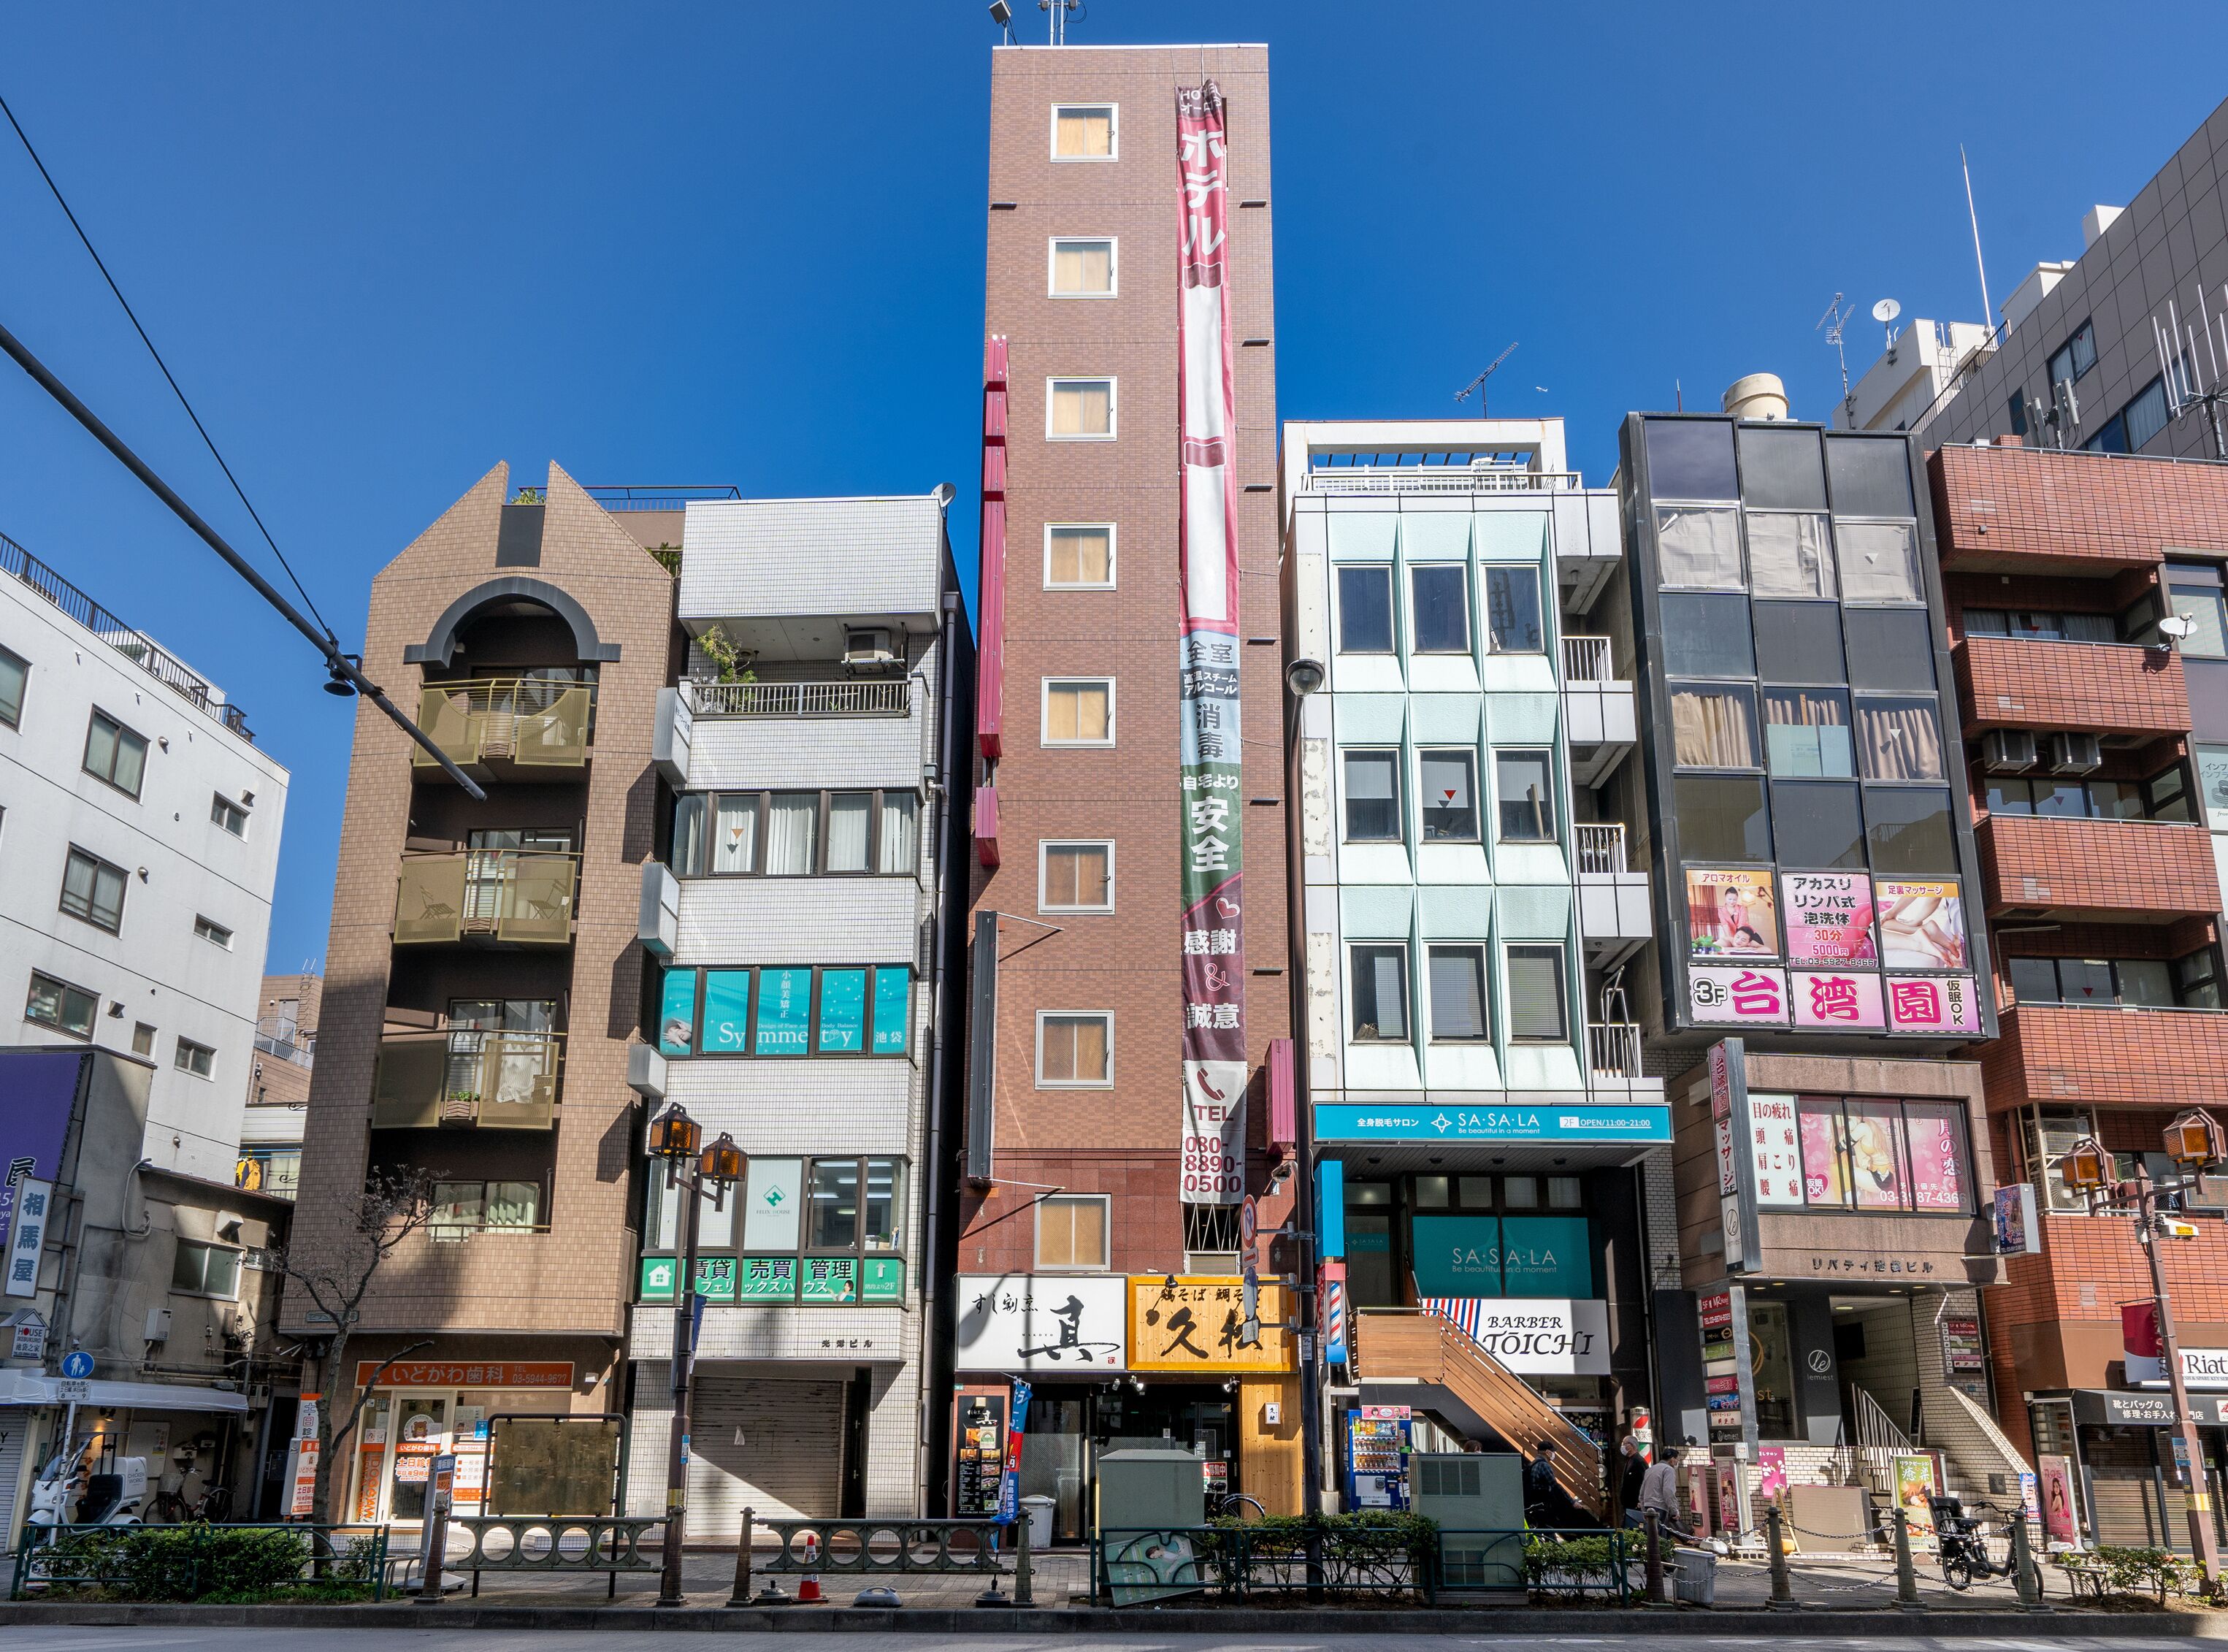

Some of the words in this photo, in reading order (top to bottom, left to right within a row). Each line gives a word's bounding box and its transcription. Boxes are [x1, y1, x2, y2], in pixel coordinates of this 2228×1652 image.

[1181, 129, 1225, 257] ホテル
[1187, 639, 1233, 665] 全室
[1184, 670, 1238, 684] 高温スチーム
[1184, 684, 1237, 696] アルコール
[1195, 703, 1224, 759] 消毒
[1183, 773, 1239, 791] 自宅より
[1191, 795, 1229, 873] 安全
[1701, 873, 1750, 884] アロマオイル
[1793, 876, 1852, 891] アカスリ
[1888, 884, 1943, 895] 足裏マッサージ
[1794, 895, 1856, 909] リンパ式
[1804, 911, 1851, 925] 泡洗体
[1184, 929, 1236, 956] 感謝
[1814, 929, 1844, 942] 30分
[1812, 944, 1849, 957] 5000円
[1204, 963, 1230, 992] &
[781, 970, 792, 1019] 小顔美矯正
[1693, 977, 1728, 1007] 3F
[1730, 970, 1943, 1025] 台湾園
[1187, 1002, 1240, 1030] 誠意
[876, 1030, 903, 1044] 池袋
[1193, 1104, 1234, 1122] TEL
[1753, 1102, 1792, 1120] 目の疲れ
[1357, 1117, 1420, 1128] 全身脱毛サロン
[1563, 1117, 1575, 1128] 2F
[1719, 1120, 1734, 1186] マッサージ
[1939, 1118, 1961, 1177] 月の恋
[1758, 1153, 1796, 1171] 肩こり
[1184, 1174, 1241, 1193] 0500
[1723, 1183, 1736, 1195] 2F
[1806, 1178, 1823, 1188] 仮眠
[2002, 1200, 2013, 1243] モナリザ
[12, 1192, 45, 1282] 相馬屋
[750, 1259, 792, 1280] 売買
[810, 1259, 852, 1280] 管理
[1487, 1315, 1563, 1329] BARBER
[392, 1366, 505, 1384] いどがわ歯科
[513, 1373, 567, 1384] 03-5944-9677
[1807, 1373, 1834, 1381] lemiest
[2112, 1399, 2163, 1410] 靴とバッグの
